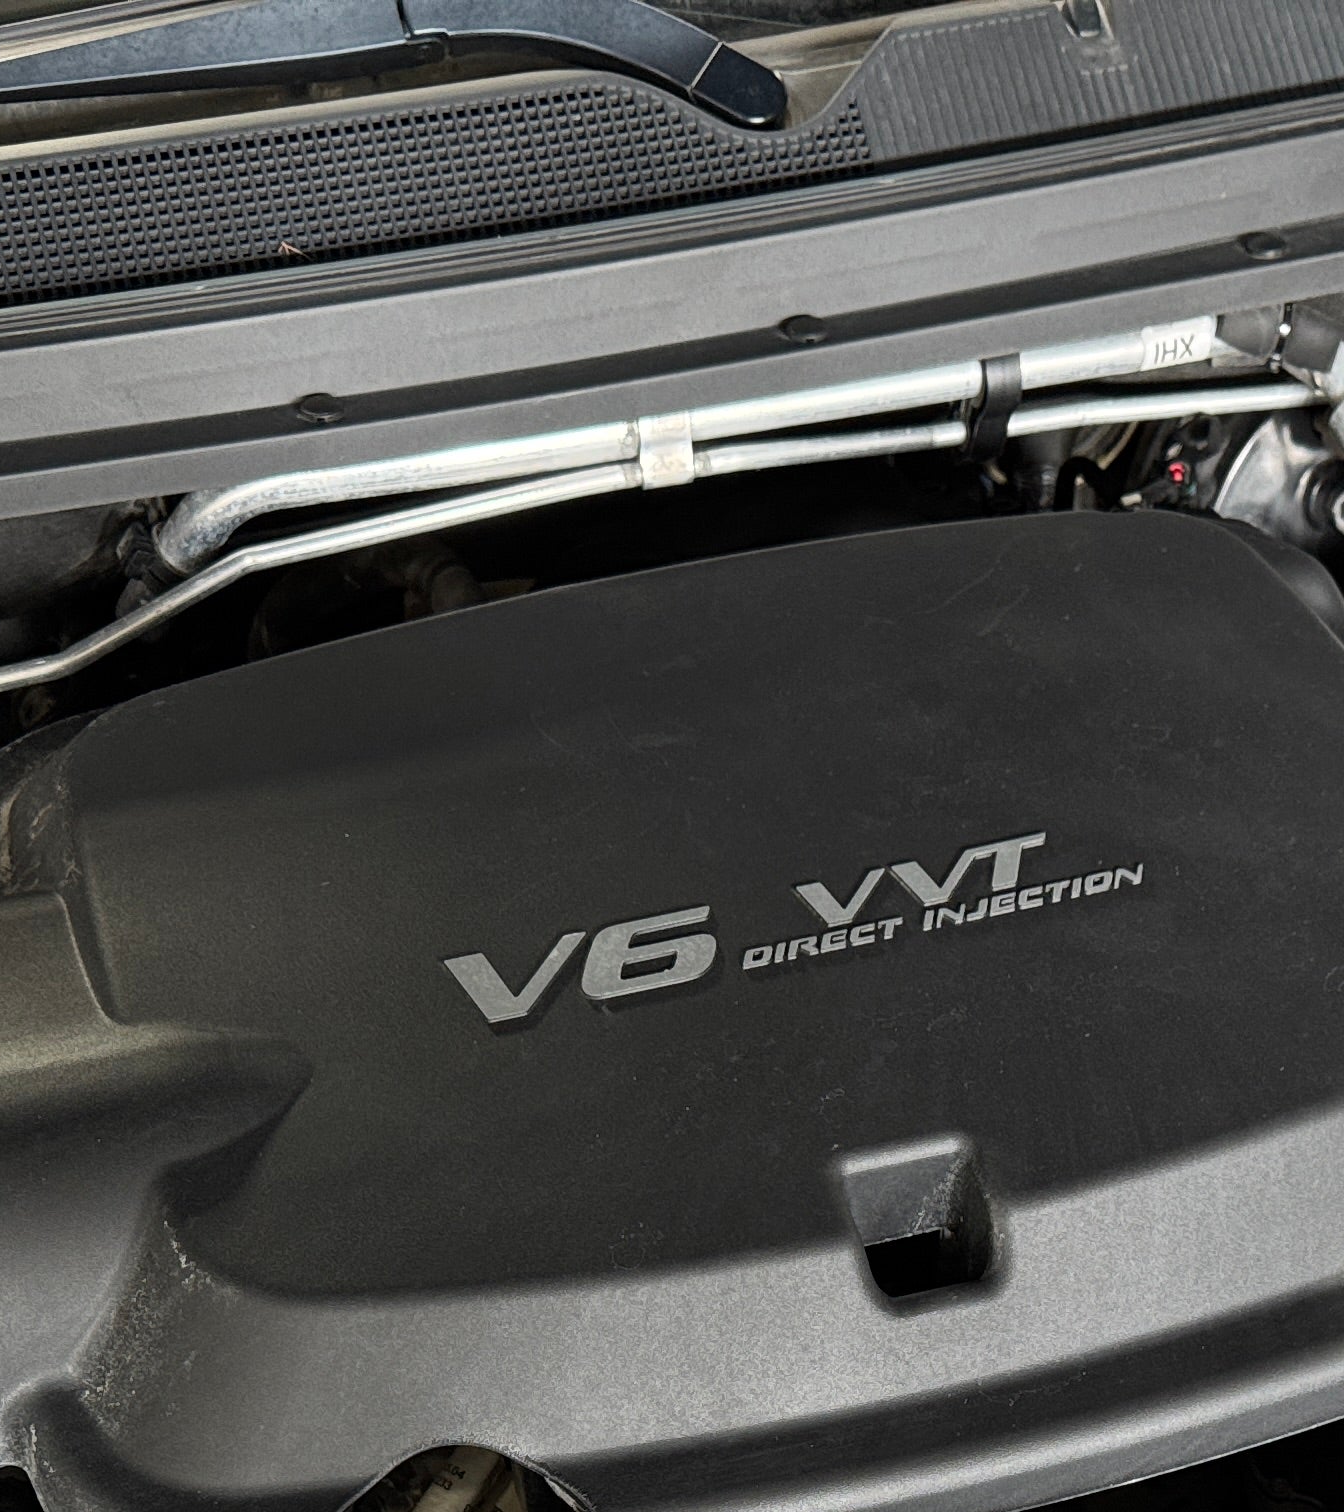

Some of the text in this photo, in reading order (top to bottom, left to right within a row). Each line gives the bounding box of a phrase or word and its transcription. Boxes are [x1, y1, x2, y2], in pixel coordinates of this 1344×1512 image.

[1154, 334, 1195, 364] IHX
[742, 862, 1145, 972] DIRECT INJECTION
[793, 831, 1047, 926] VVT
[443, 905, 719, 1026] V6
